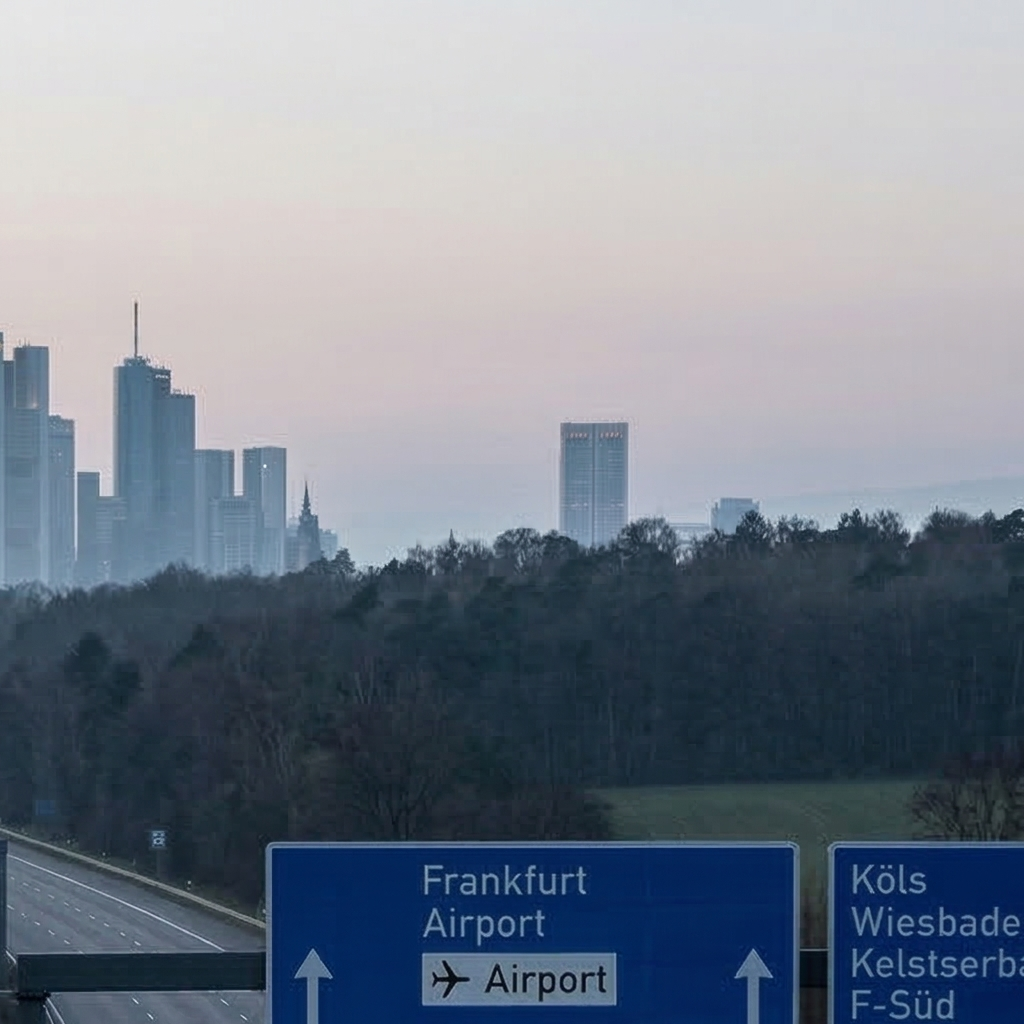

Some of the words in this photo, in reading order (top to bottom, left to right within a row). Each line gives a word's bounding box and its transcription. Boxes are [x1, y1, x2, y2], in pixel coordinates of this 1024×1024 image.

[423, 864, 587, 896] Frankfurt
[852, 863, 927, 895] Köls
[422, 907, 546, 947] Airport
[484, 963, 607, 1002] Airport
[851, 989, 955, 1020] F-Süd
